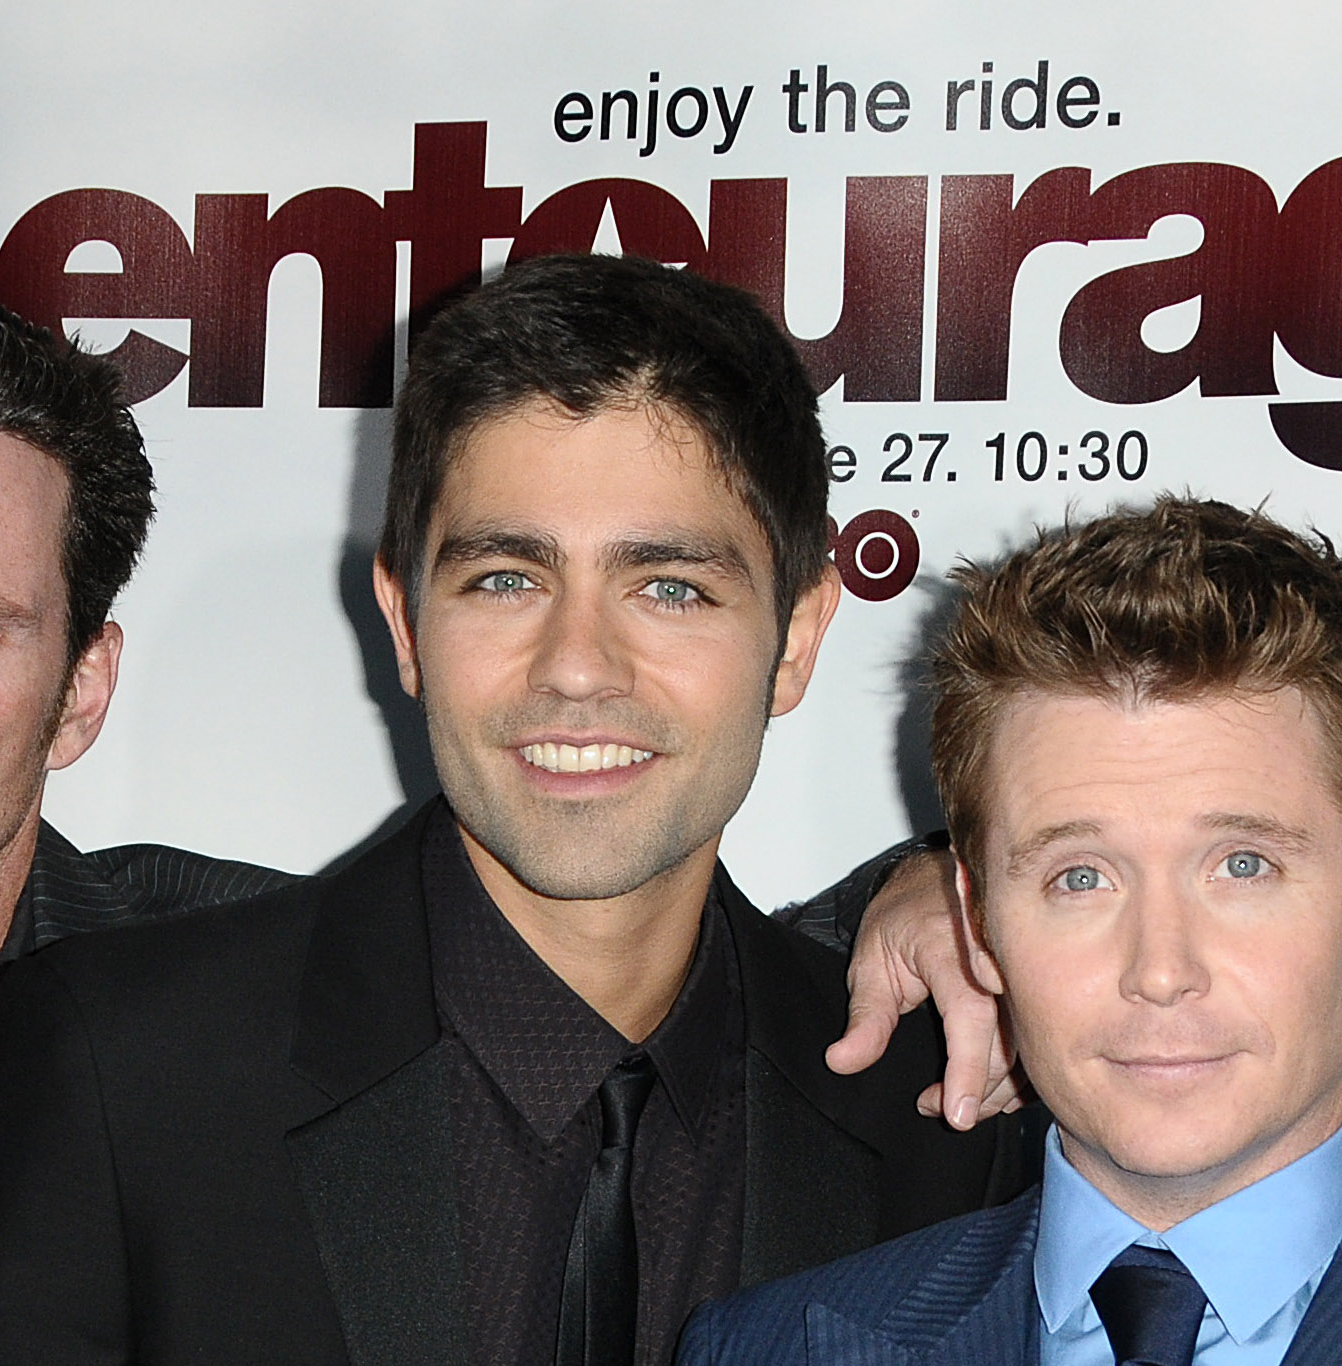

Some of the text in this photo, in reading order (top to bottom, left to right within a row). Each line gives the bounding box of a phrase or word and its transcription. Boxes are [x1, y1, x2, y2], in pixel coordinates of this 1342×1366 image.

[554, 60, 1120, 157] enjoy the ride.
[881, 433, 957, 482] 27.
[985, 430, 1149, 481] 10:30
